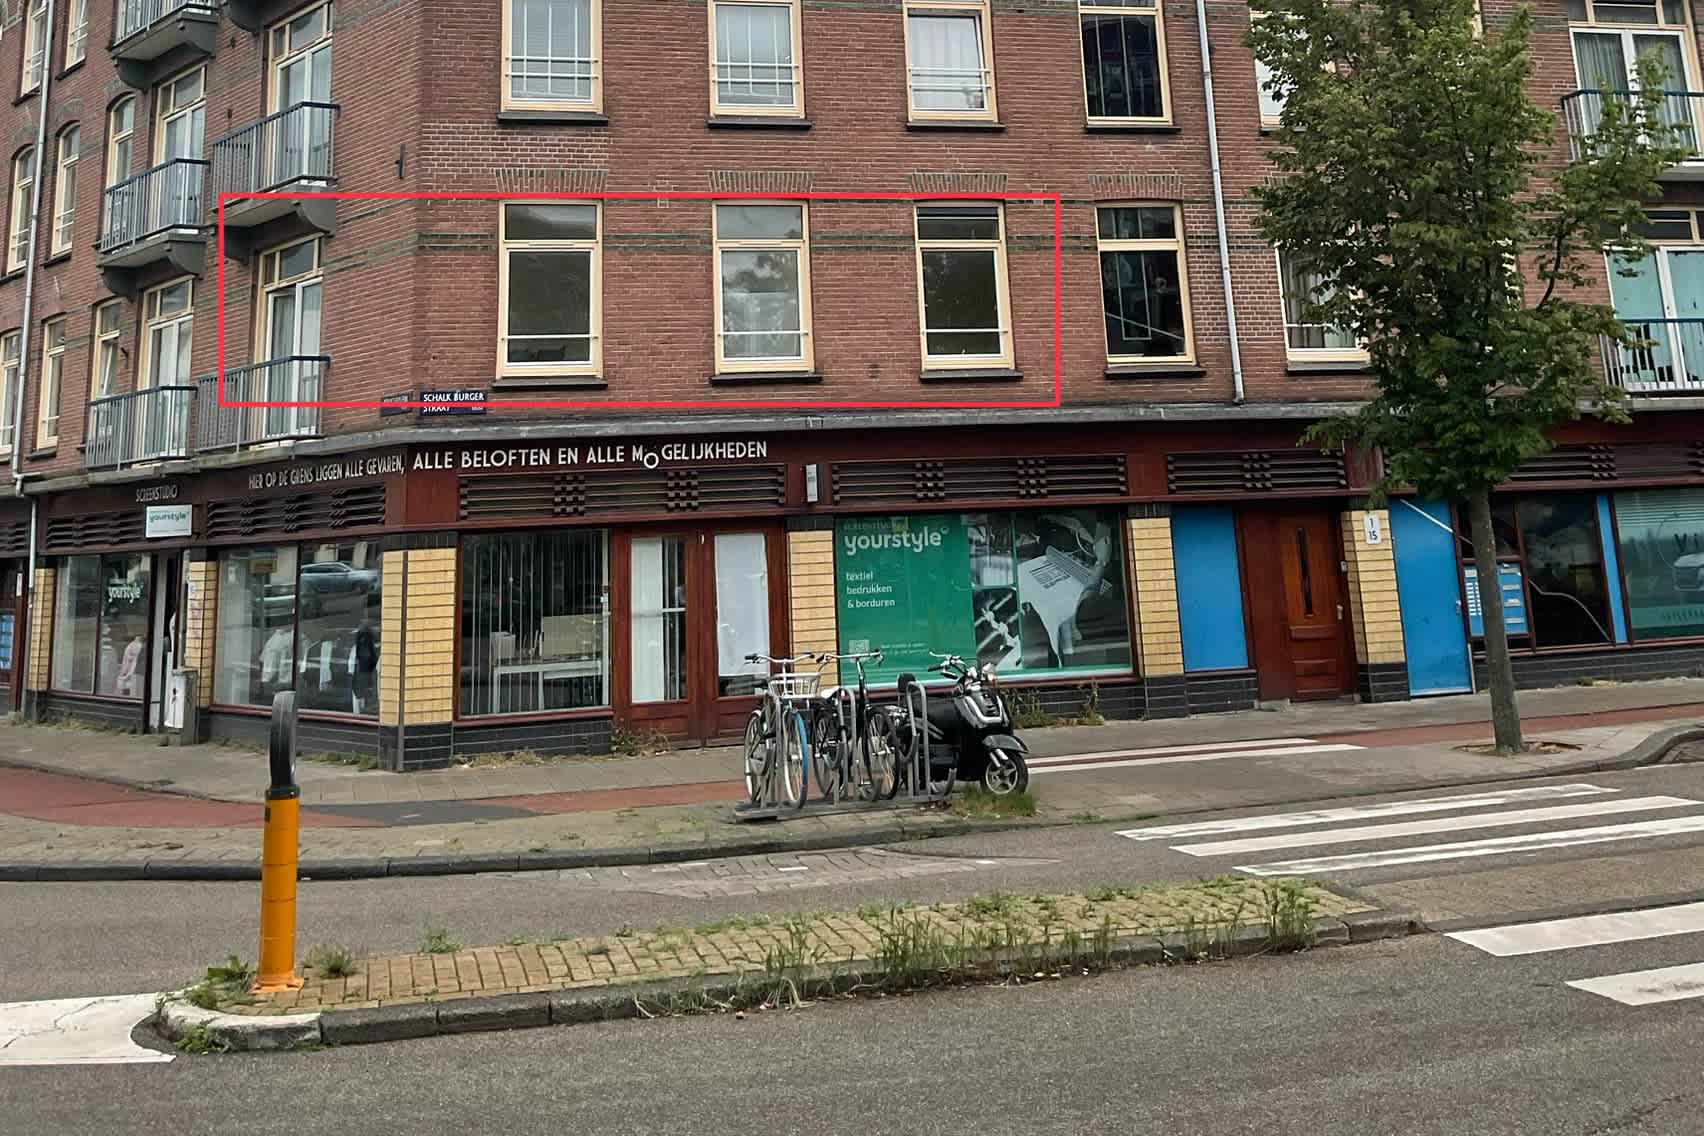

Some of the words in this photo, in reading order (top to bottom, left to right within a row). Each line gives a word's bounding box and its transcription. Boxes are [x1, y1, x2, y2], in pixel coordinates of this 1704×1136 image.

[423, 393, 451, 402] SCHALK
[454, 392, 484, 401] BURGER
[412, 451, 453, 470] ALLE
[461, 448, 550, 468] BELOFTEN
[558, 447, 578, 465] EN
[586, 445, 625, 463] ALLE
[249, 472, 263, 489] HIER
[265, 472, 277, 488] OP
[278, 470, 288, 486] DE
[290, 466, 313, 485] GRENS
[315, 463, 343, 481] LIGGEN
[344, 459, 364, 478] ALLE
[1369, 530, 1378, 540] 15
[844, 526, 942, 556] yourstyle
[846, 571, 873, 581] textiel
[847, 584, 892, 594] bedrukken
[847, 599, 854, 608] &
[856, 598, 895, 608] borduren
